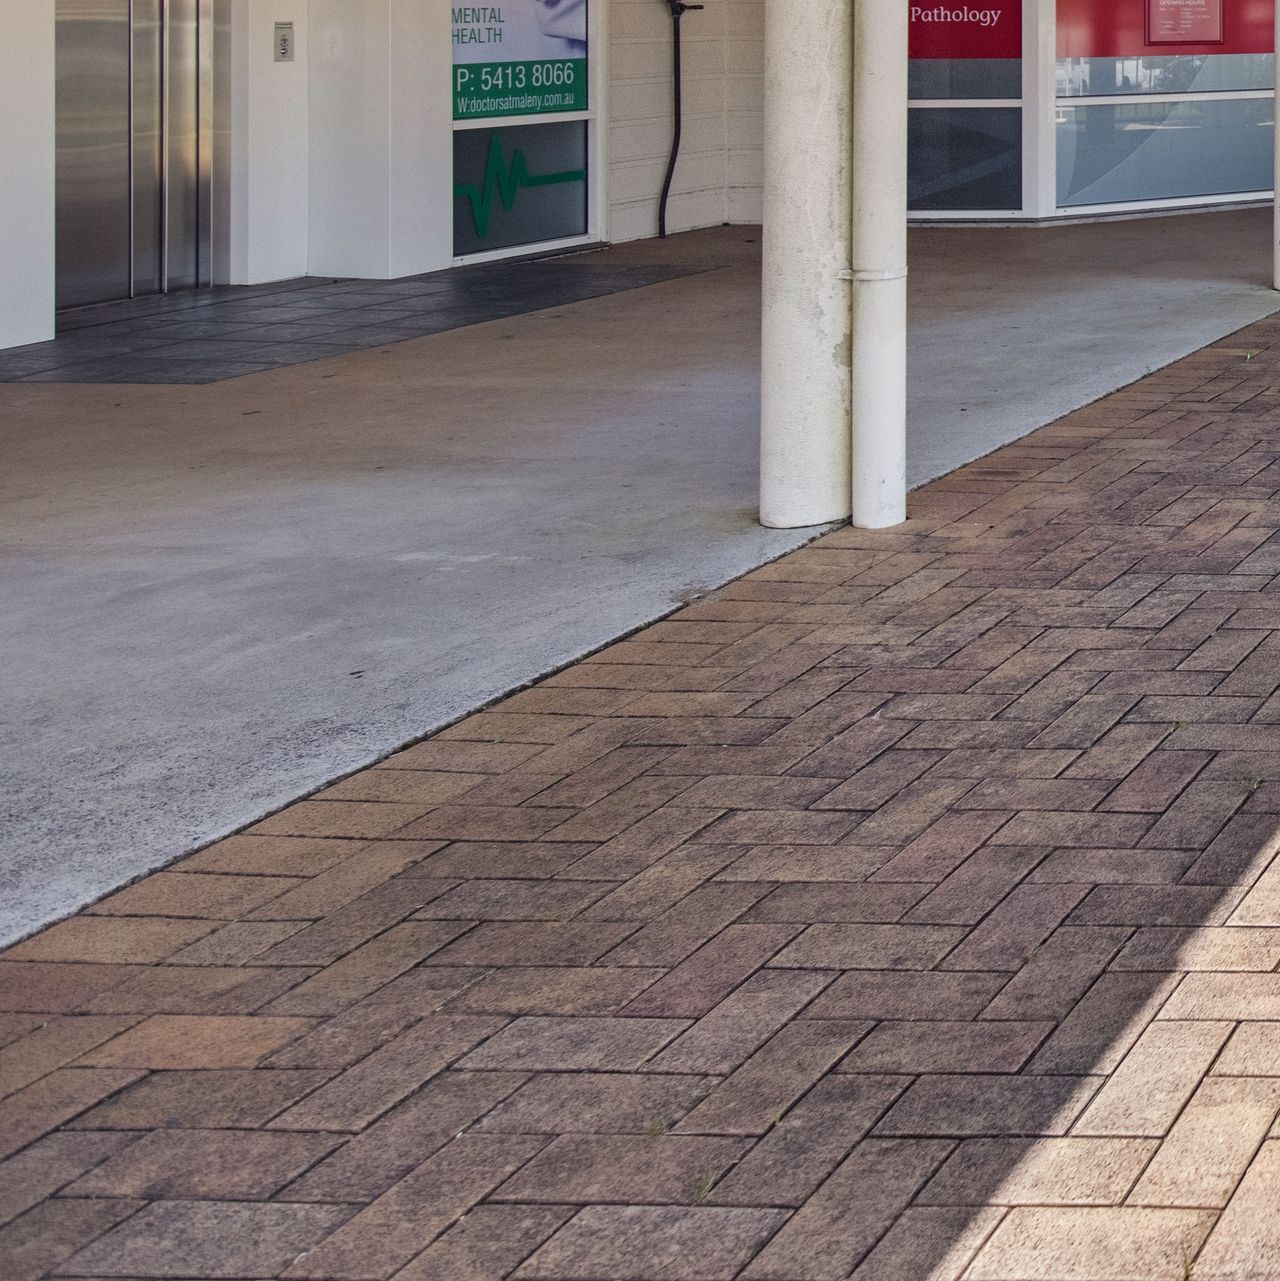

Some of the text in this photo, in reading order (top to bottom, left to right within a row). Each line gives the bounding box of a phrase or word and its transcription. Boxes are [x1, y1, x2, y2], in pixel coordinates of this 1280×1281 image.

[451, 7, 504, 24] MENTAL
[911, 6, 1001, 26] Pathology
[452, 28, 502, 44] HEALTH
[457, 62, 574, 92] P: 5413 8066
